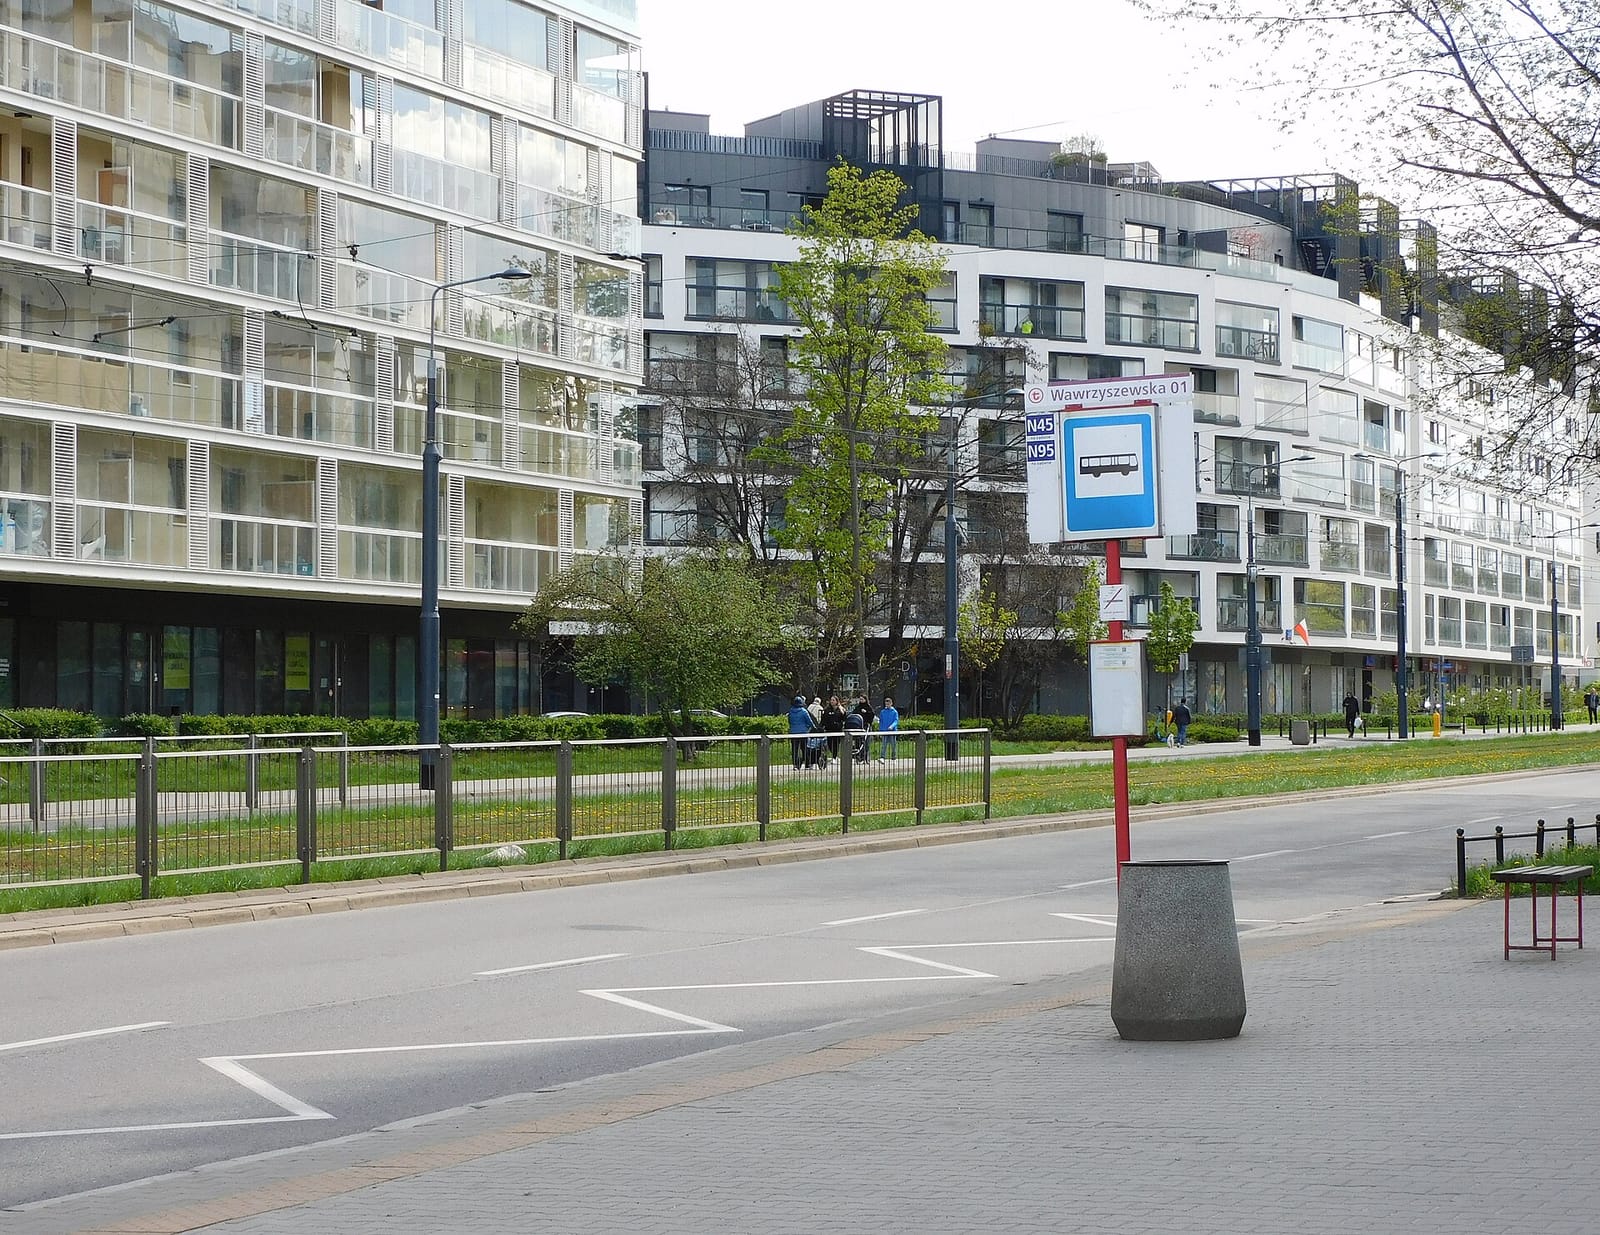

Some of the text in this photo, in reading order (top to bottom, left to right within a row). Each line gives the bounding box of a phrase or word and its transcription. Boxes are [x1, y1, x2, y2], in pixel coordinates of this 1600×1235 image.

[1051, 381, 1166, 402] Wawrzyszewska
[1170, 380, 1188, 394] 01
[1027, 417, 1054, 433] N45
[1028, 443, 1055, 458] N95
